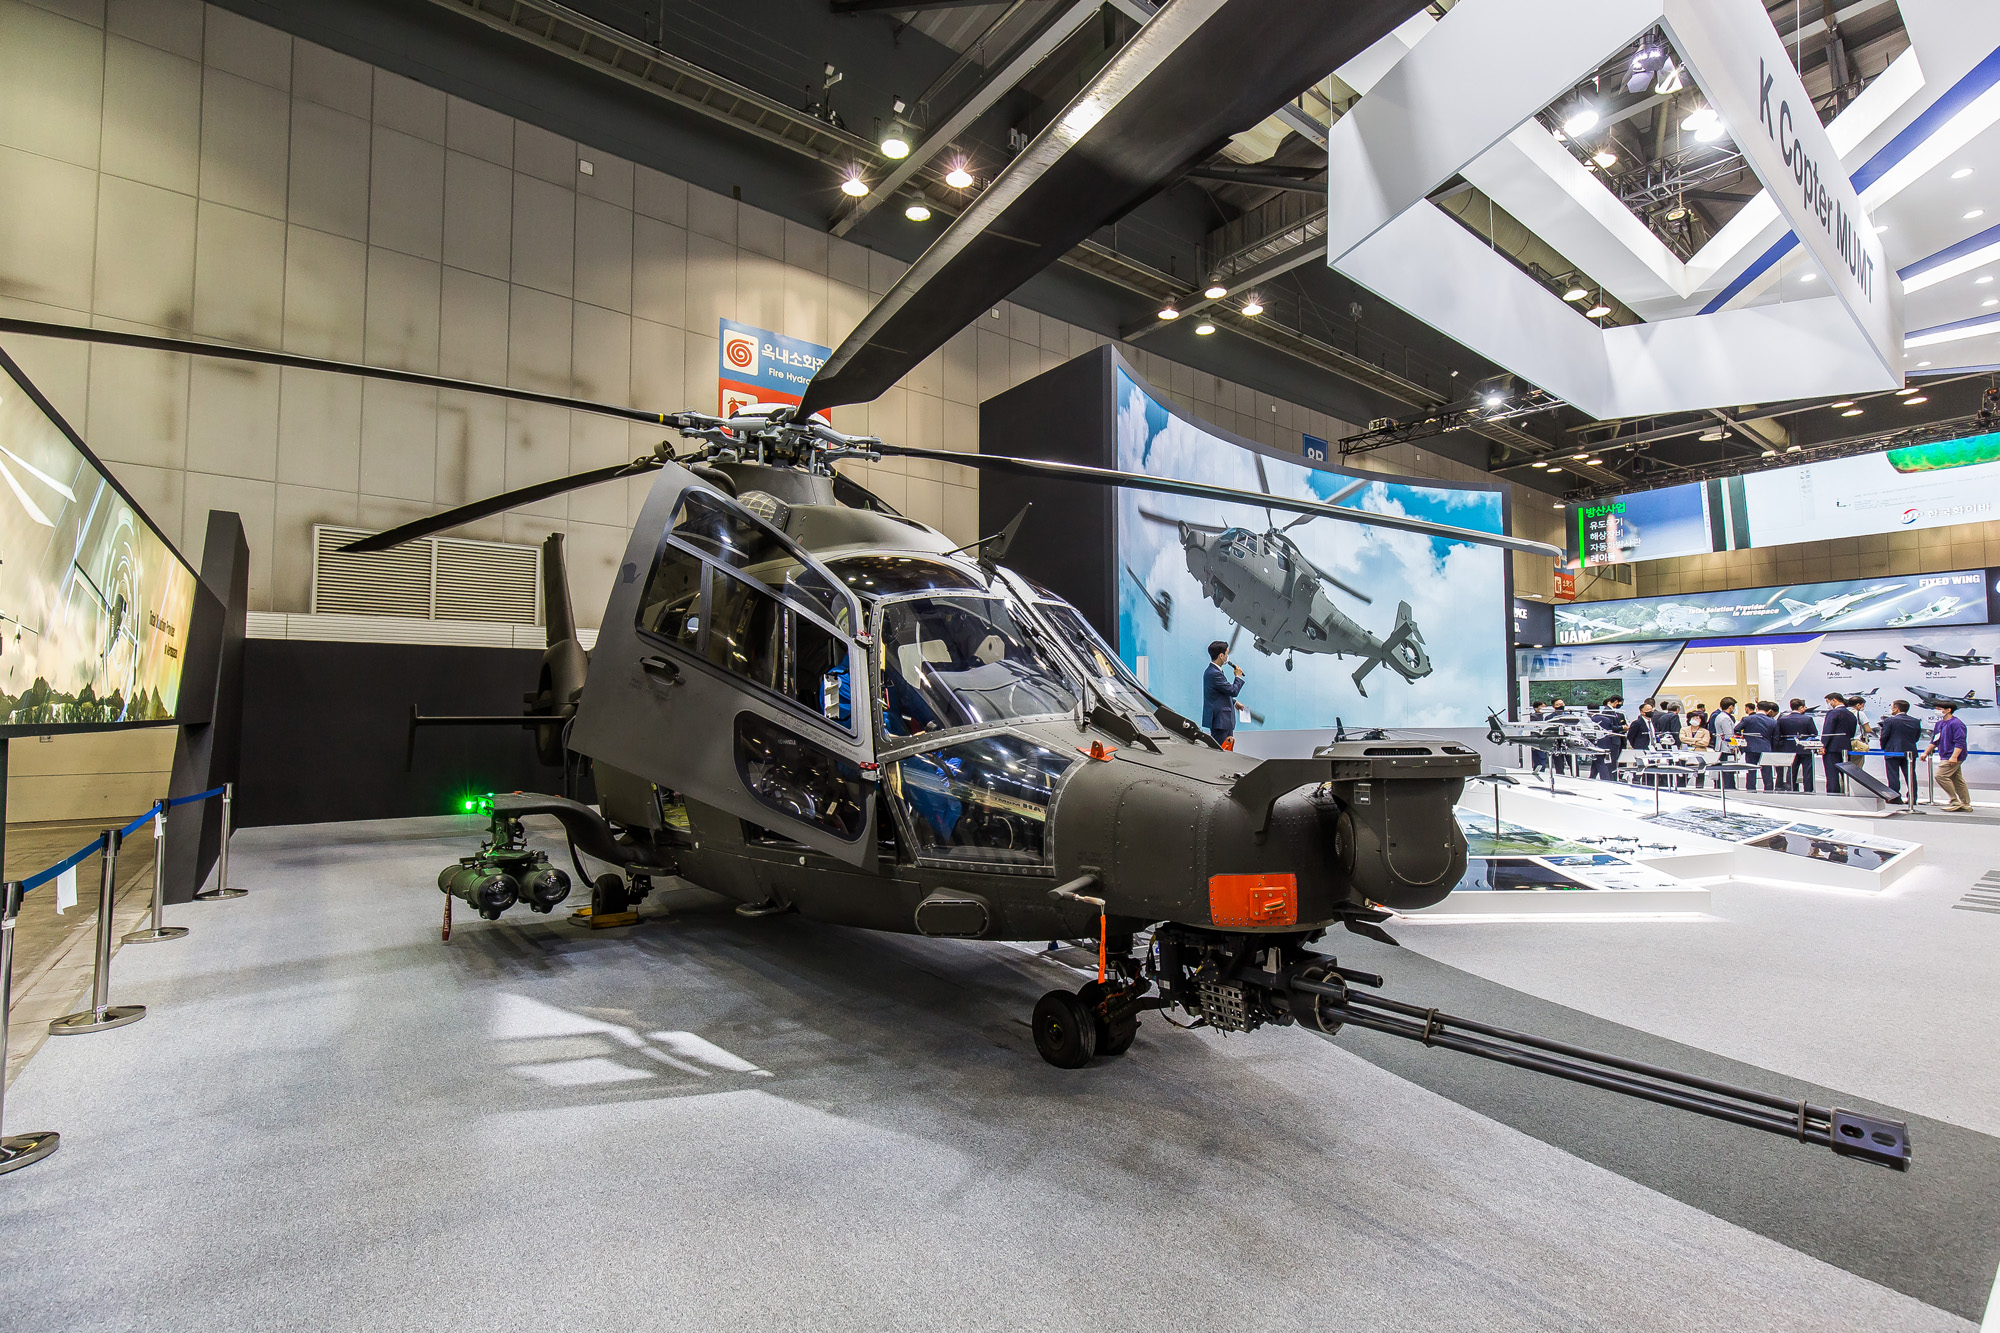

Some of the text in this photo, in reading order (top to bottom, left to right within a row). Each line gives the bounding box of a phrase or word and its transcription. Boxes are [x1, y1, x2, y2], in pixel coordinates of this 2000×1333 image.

[1758, 56, 1874, 304] K Copter MUMT
[768, 367, 785, 379] Fire
[1585, 502, 1626, 519] 방산사업
[1927, 502, 1991, 519] 한국화이바
[1919, 574, 1981, 587] FIXED WING
[1688, 607, 1705, 615] Total
[1705, 606, 1734, 614] Solution
[1741, 608, 1780, 617] Aerospace
[1559, 630, 1592, 644] UAM
